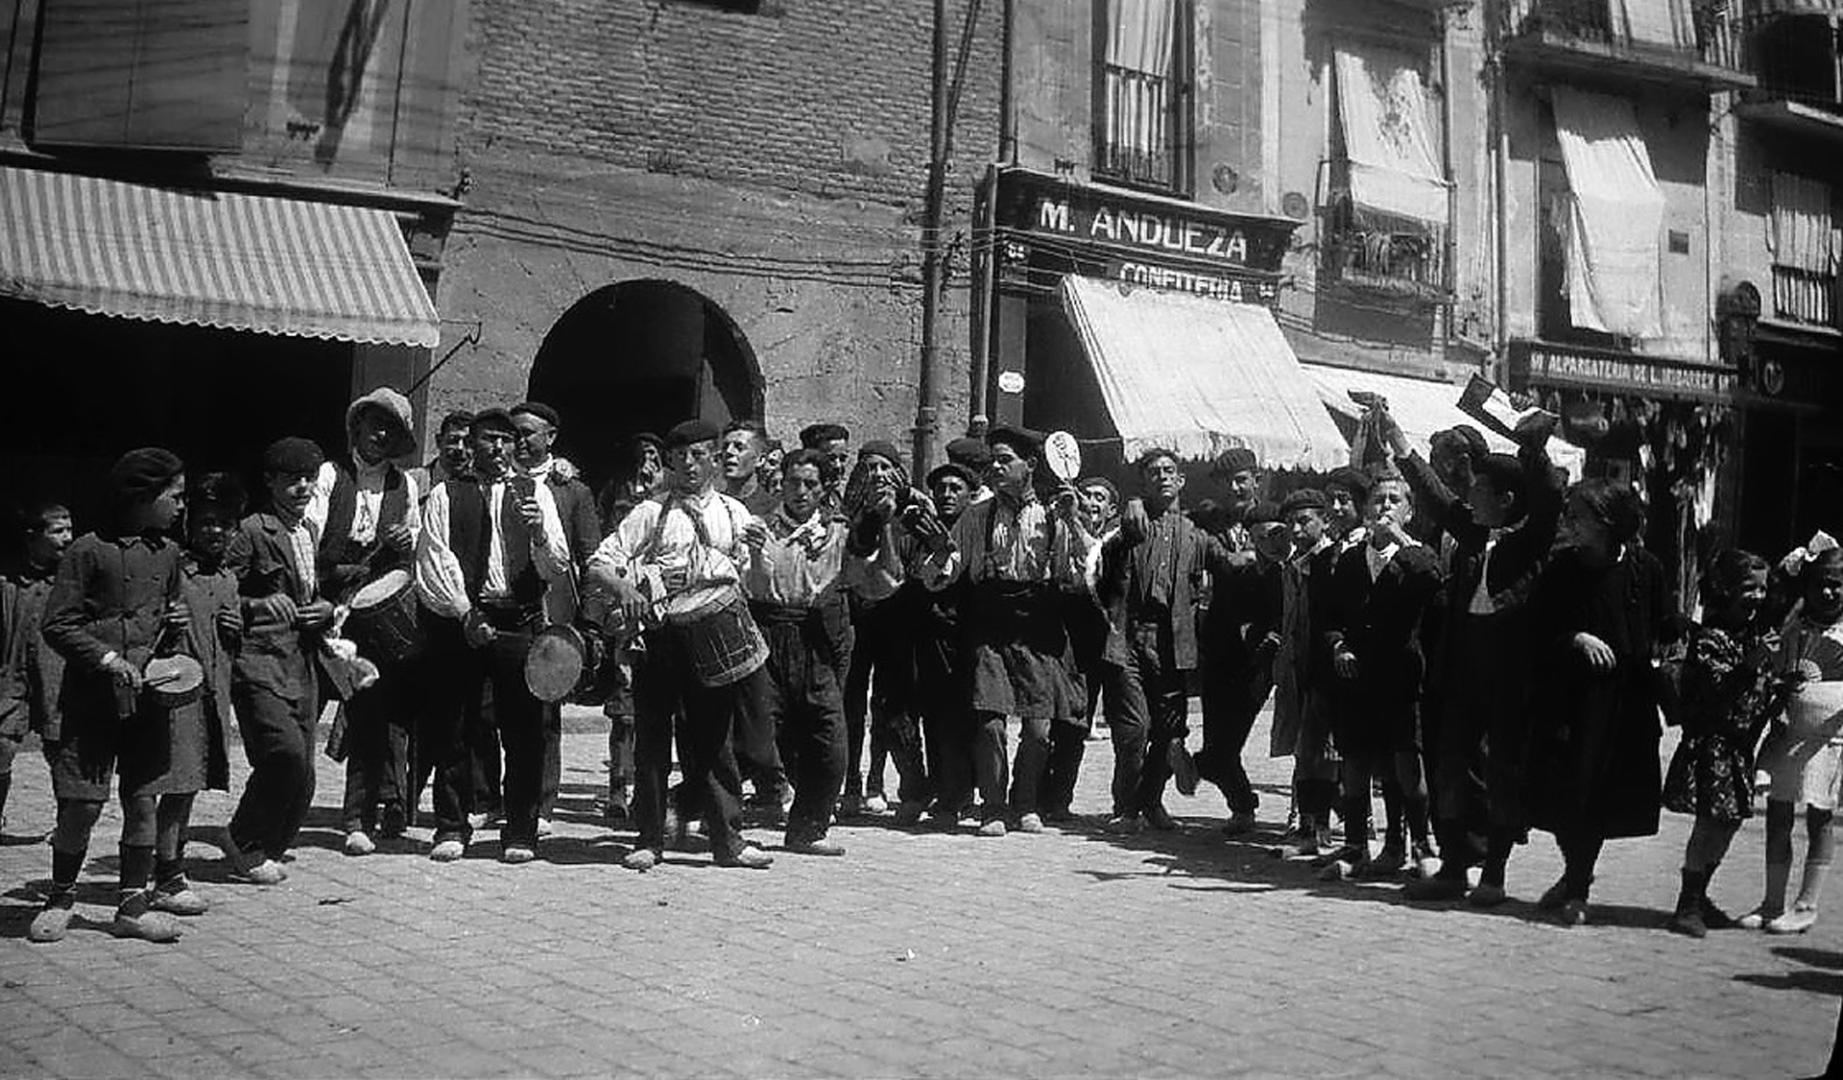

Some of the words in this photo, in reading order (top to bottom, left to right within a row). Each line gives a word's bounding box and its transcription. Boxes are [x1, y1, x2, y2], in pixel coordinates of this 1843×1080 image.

[1040, 199, 1075, 232] M.
[1090, 206, 1247, 261] ANDUEZA
[1548, 353, 1631, 381] ALPARGATERIA
[1633, 363, 1647, 383] DE
